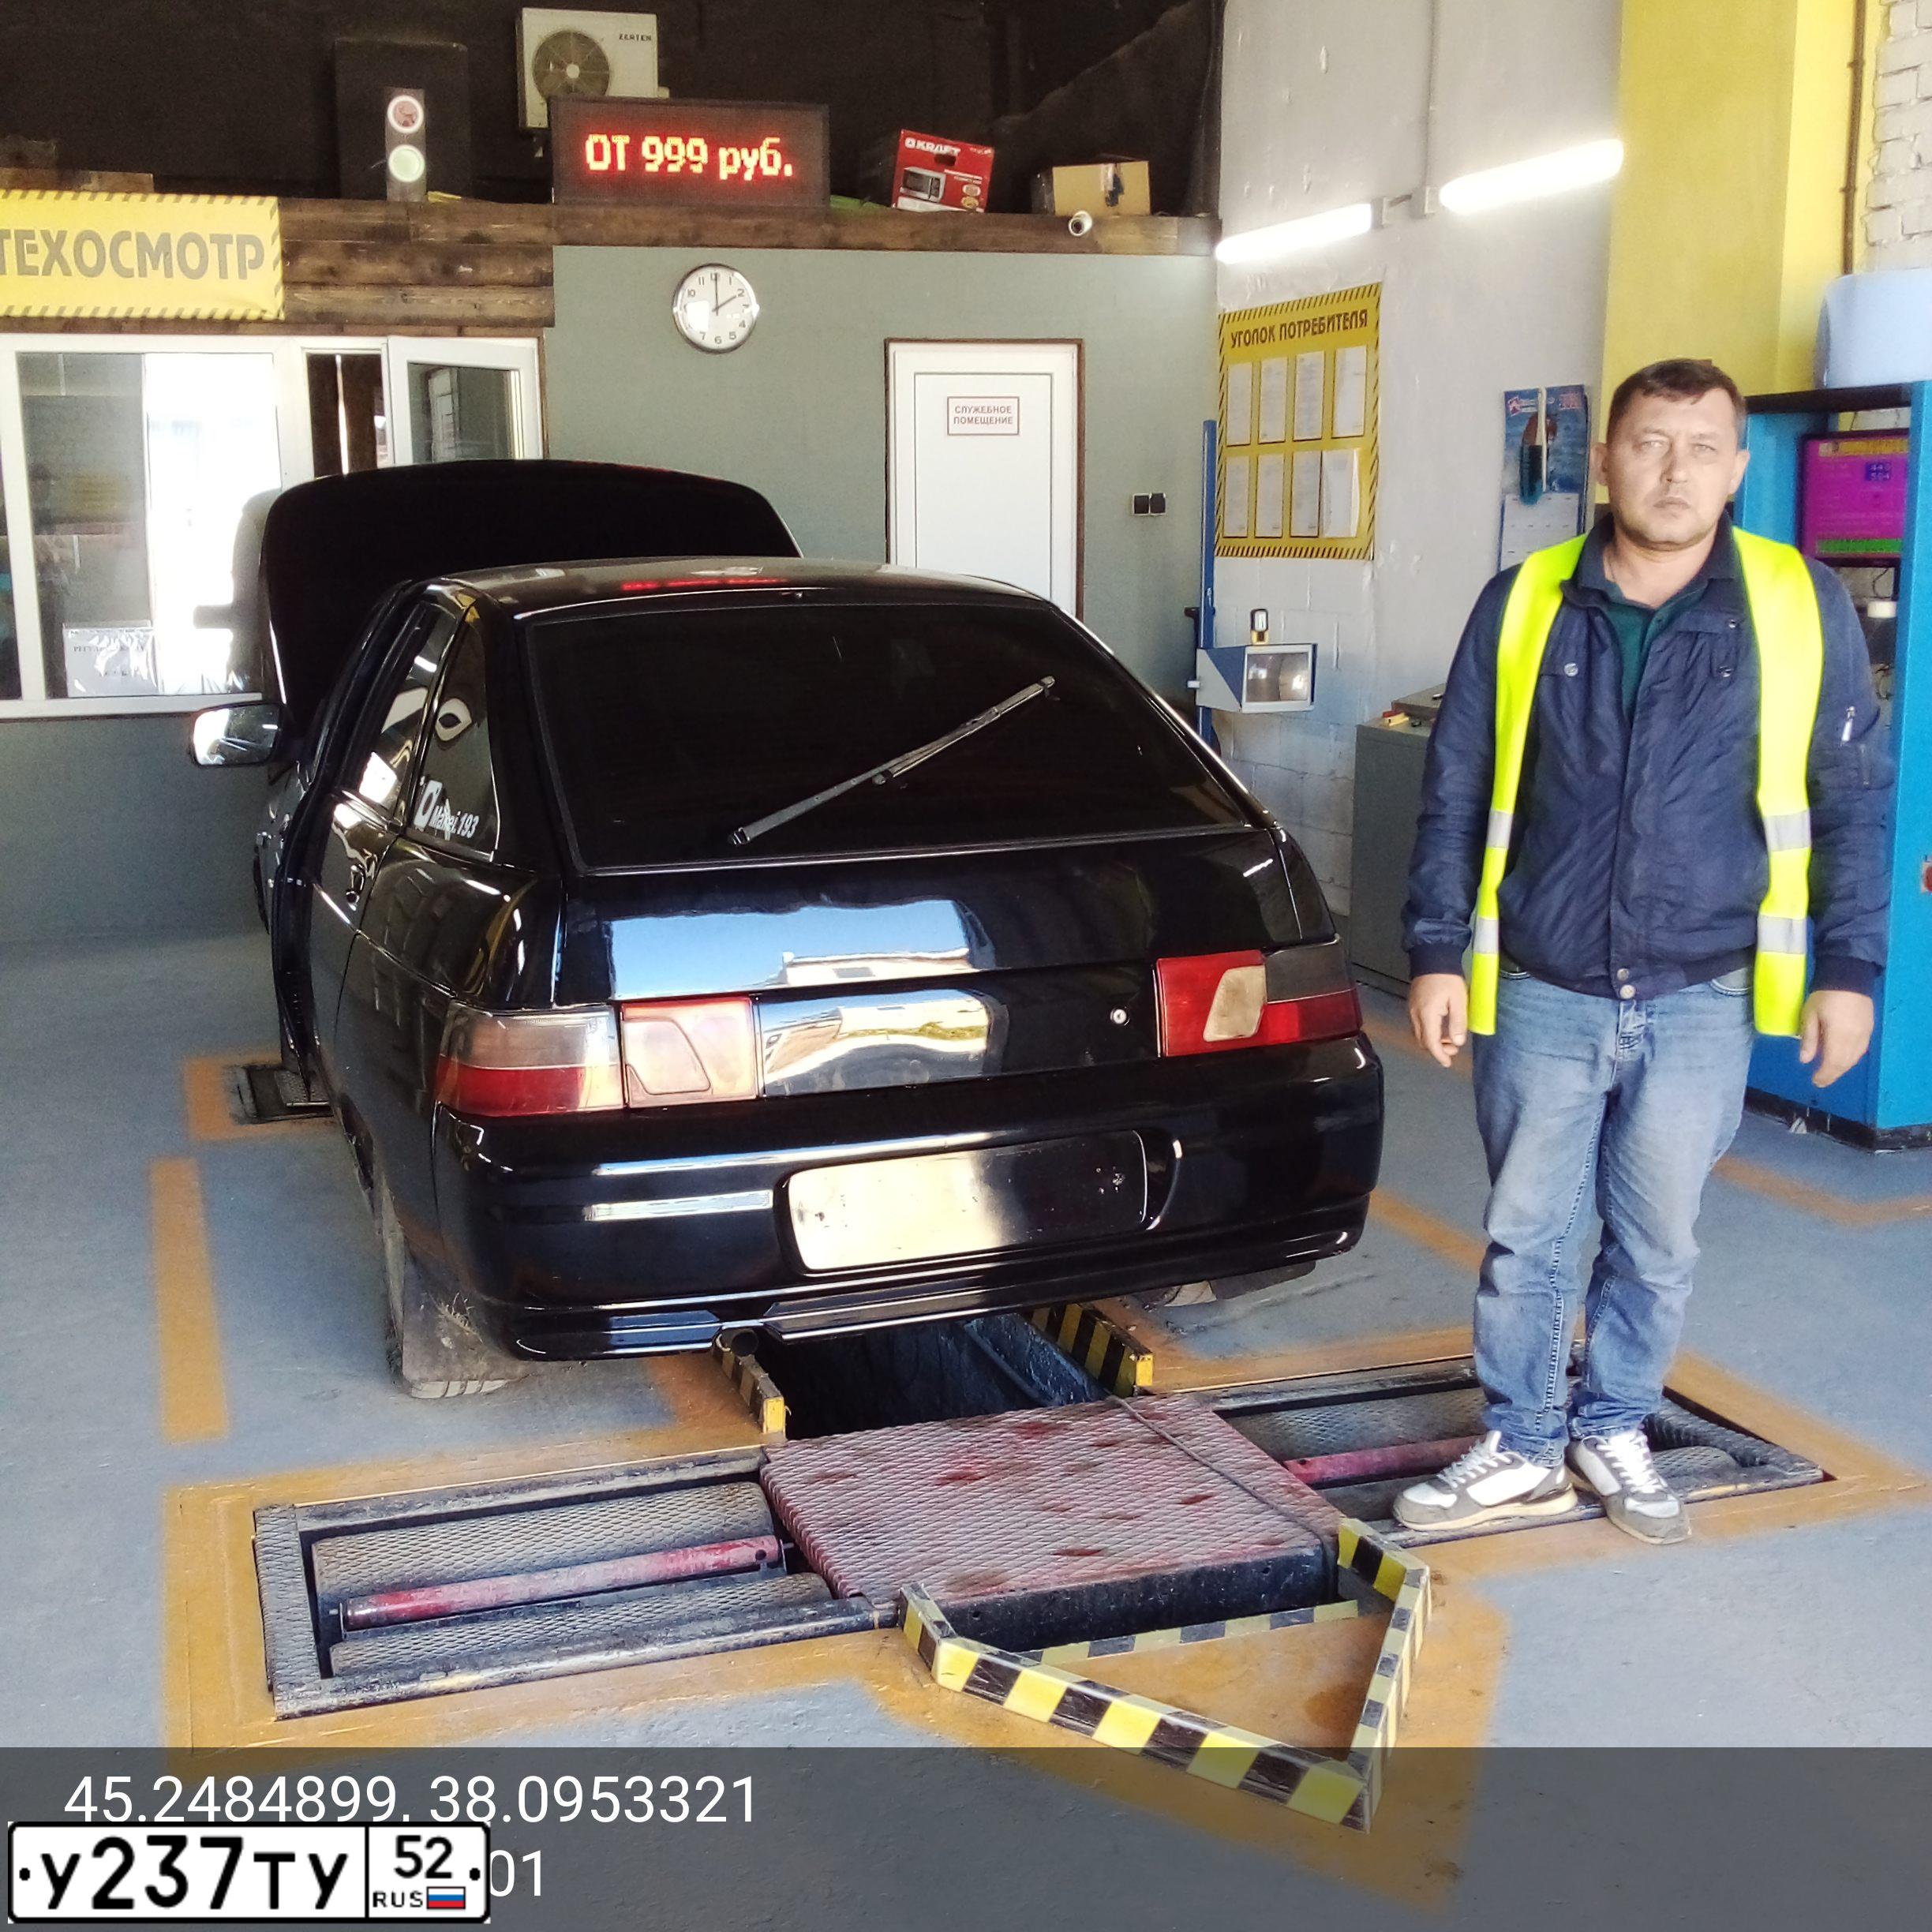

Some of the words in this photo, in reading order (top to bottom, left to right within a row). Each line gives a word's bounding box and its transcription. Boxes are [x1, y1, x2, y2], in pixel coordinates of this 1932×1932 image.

[586, 134, 630, 170] ОТ
[642, 136, 708, 174] 999
[718, 137, 792, 181] руб.
[737, 288, 745, 297] 2
[1231, 325, 1275, 348] УГОЛОК
[1279, 309, 1368, 341] ПОТРЕБИТЕЛЯ
[953, 416, 1013, 425] ПОМЕЩЕНИЕ
